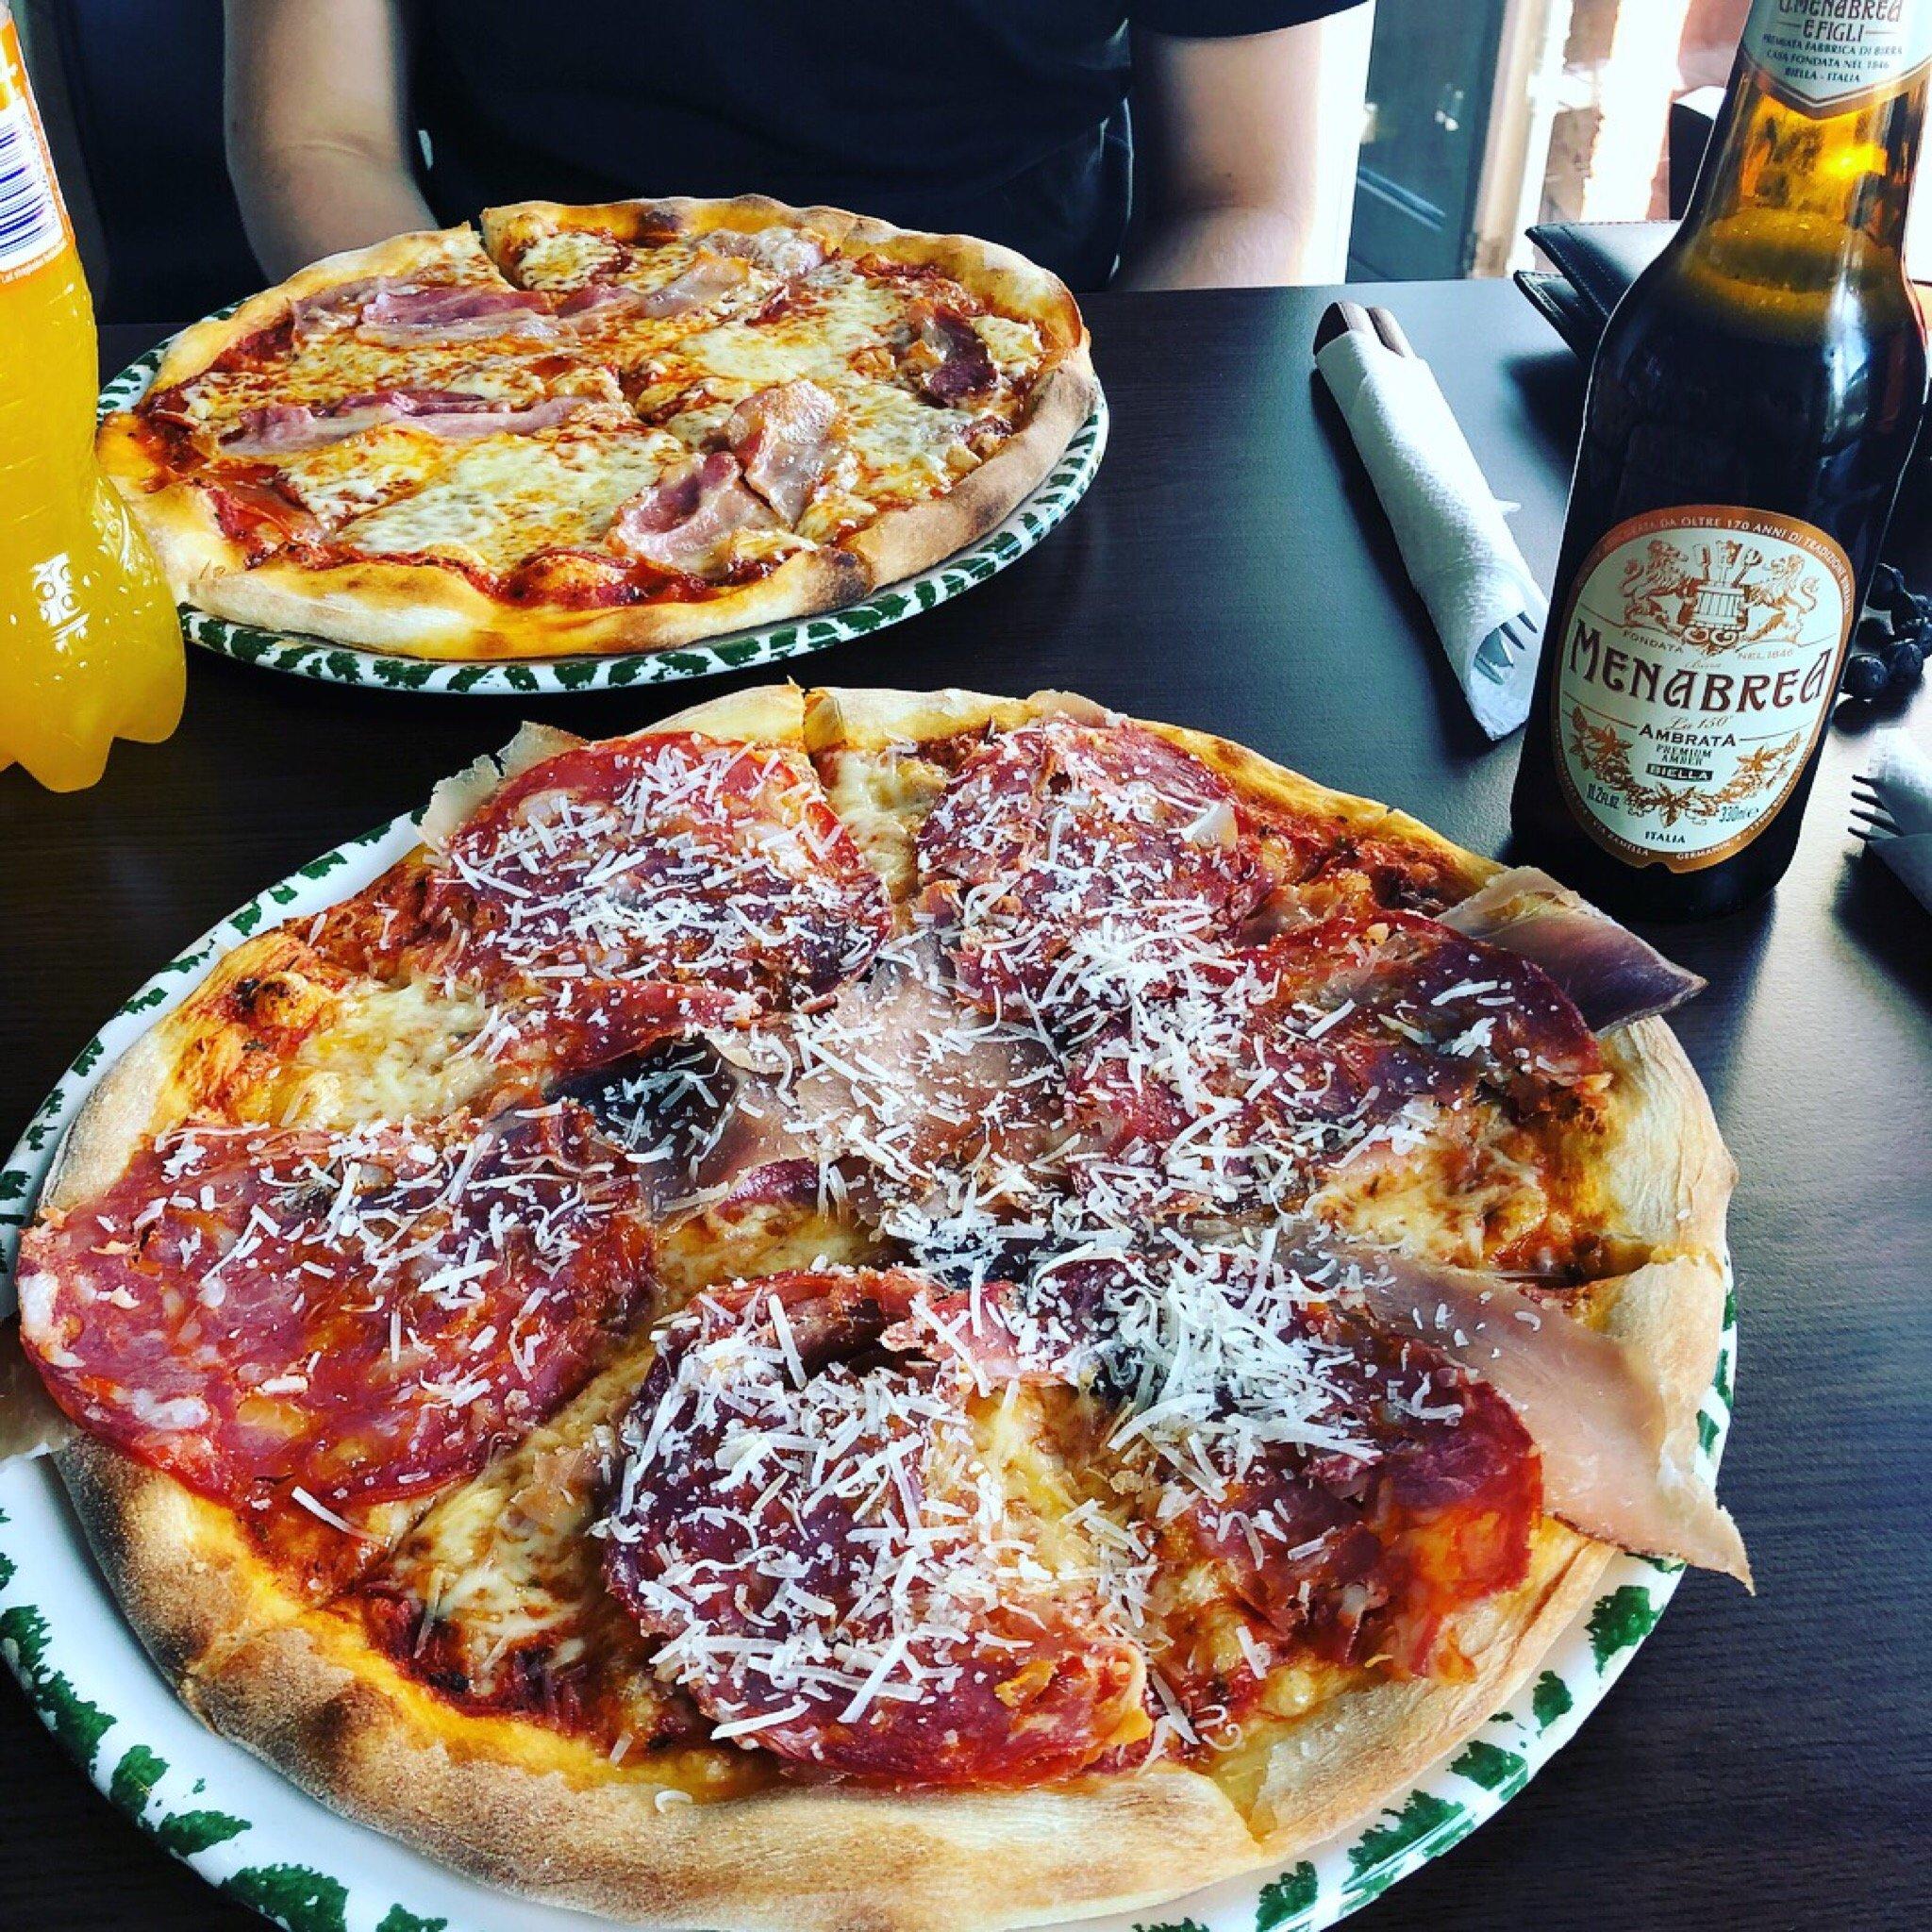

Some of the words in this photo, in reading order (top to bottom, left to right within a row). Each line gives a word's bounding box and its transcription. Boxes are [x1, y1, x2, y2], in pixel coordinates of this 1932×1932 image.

[1804, 41, 1856, 55] FABBRICA
[1790, 53, 1840, 67] FONDATA
[1680, 516, 1720, 527] OLTRE
[1726, 519, 1750, 530] 170
[1753, 524, 1788, 539] ANNI
[1622, 628, 1684, 653] FONDATA
[1569, 618, 1833, 713] MENABREA
[1639, 722, 1737, 747] AMBRATA
[1656, 743, 1712, 758] PREMIUM
[1651, 764, 1708, 780] BIELLA
[1644, 831, 1686, 843] ITALIA
